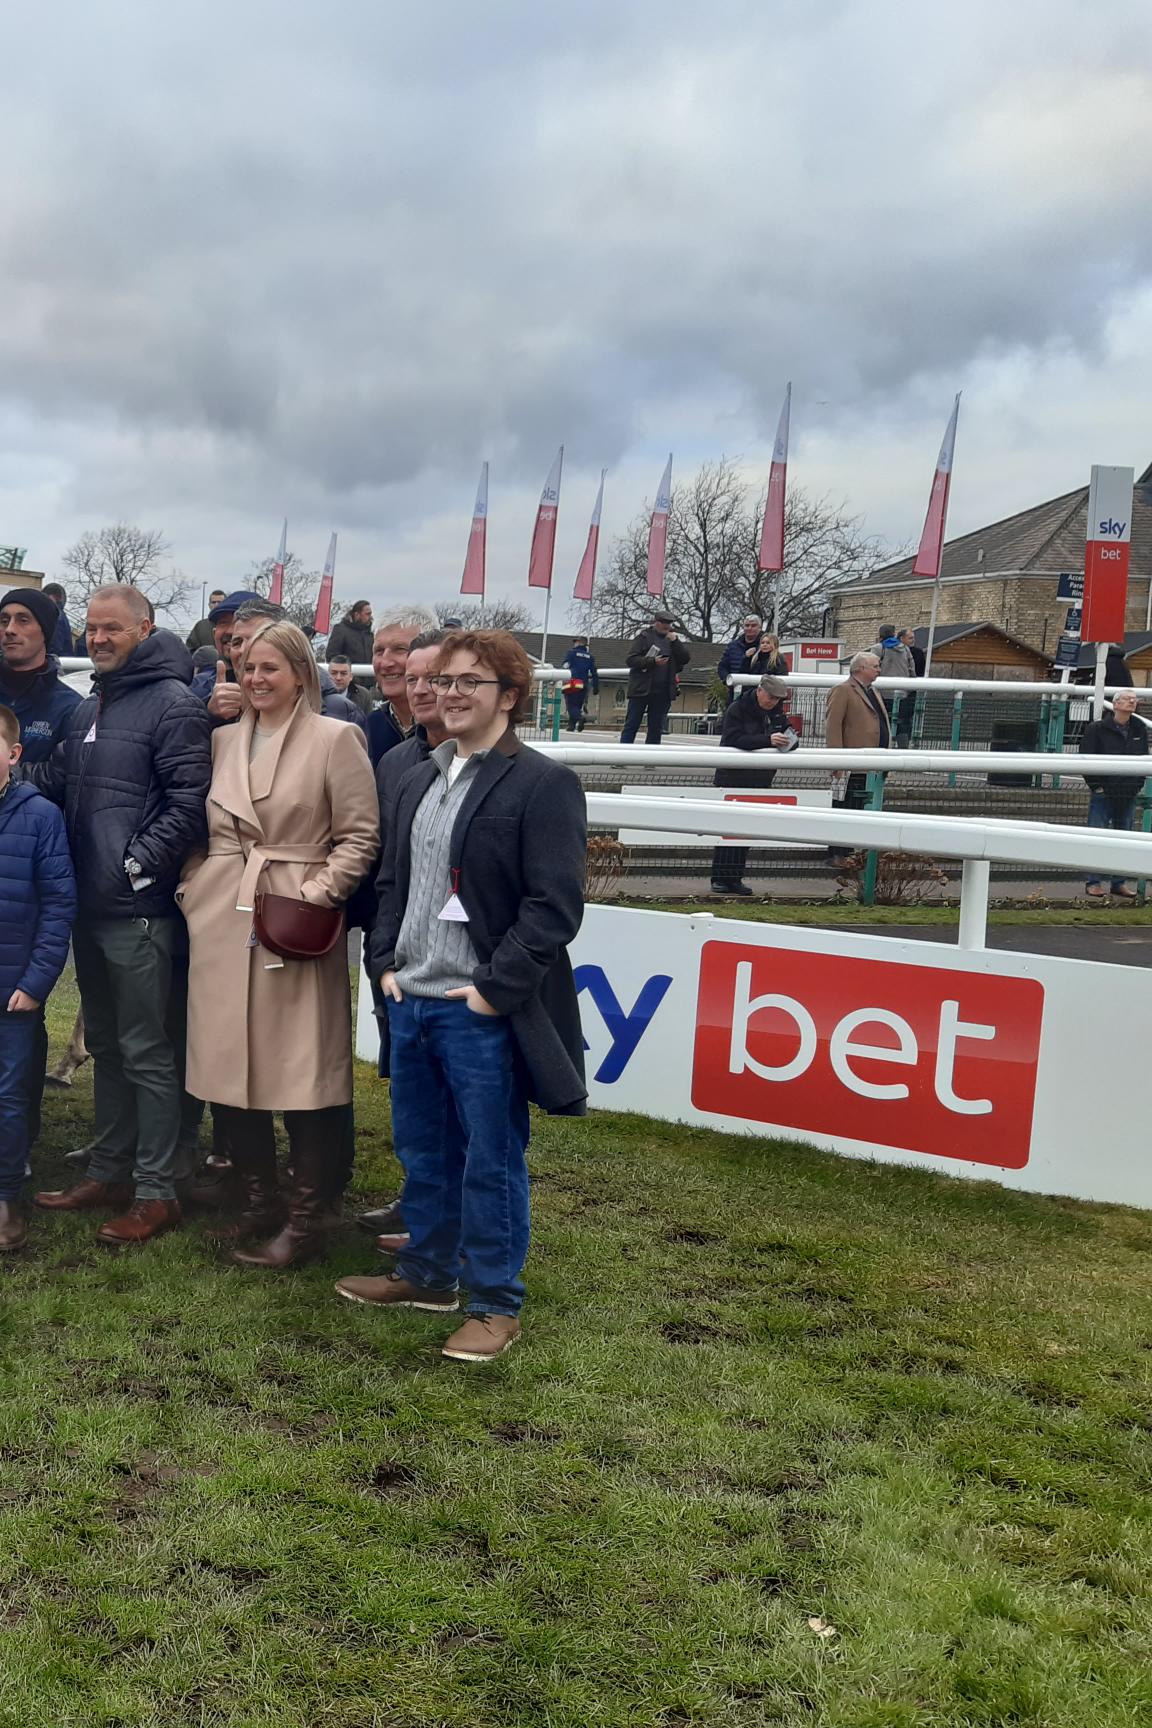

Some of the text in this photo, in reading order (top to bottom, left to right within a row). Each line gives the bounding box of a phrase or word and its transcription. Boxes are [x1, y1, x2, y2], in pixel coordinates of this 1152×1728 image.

[1099, 518, 1126, 539] sky
[1100, 547, 1121, 560] bet
[806, 647, 833, 655] Bet Here
[729, 961, 996, 1115] bet
